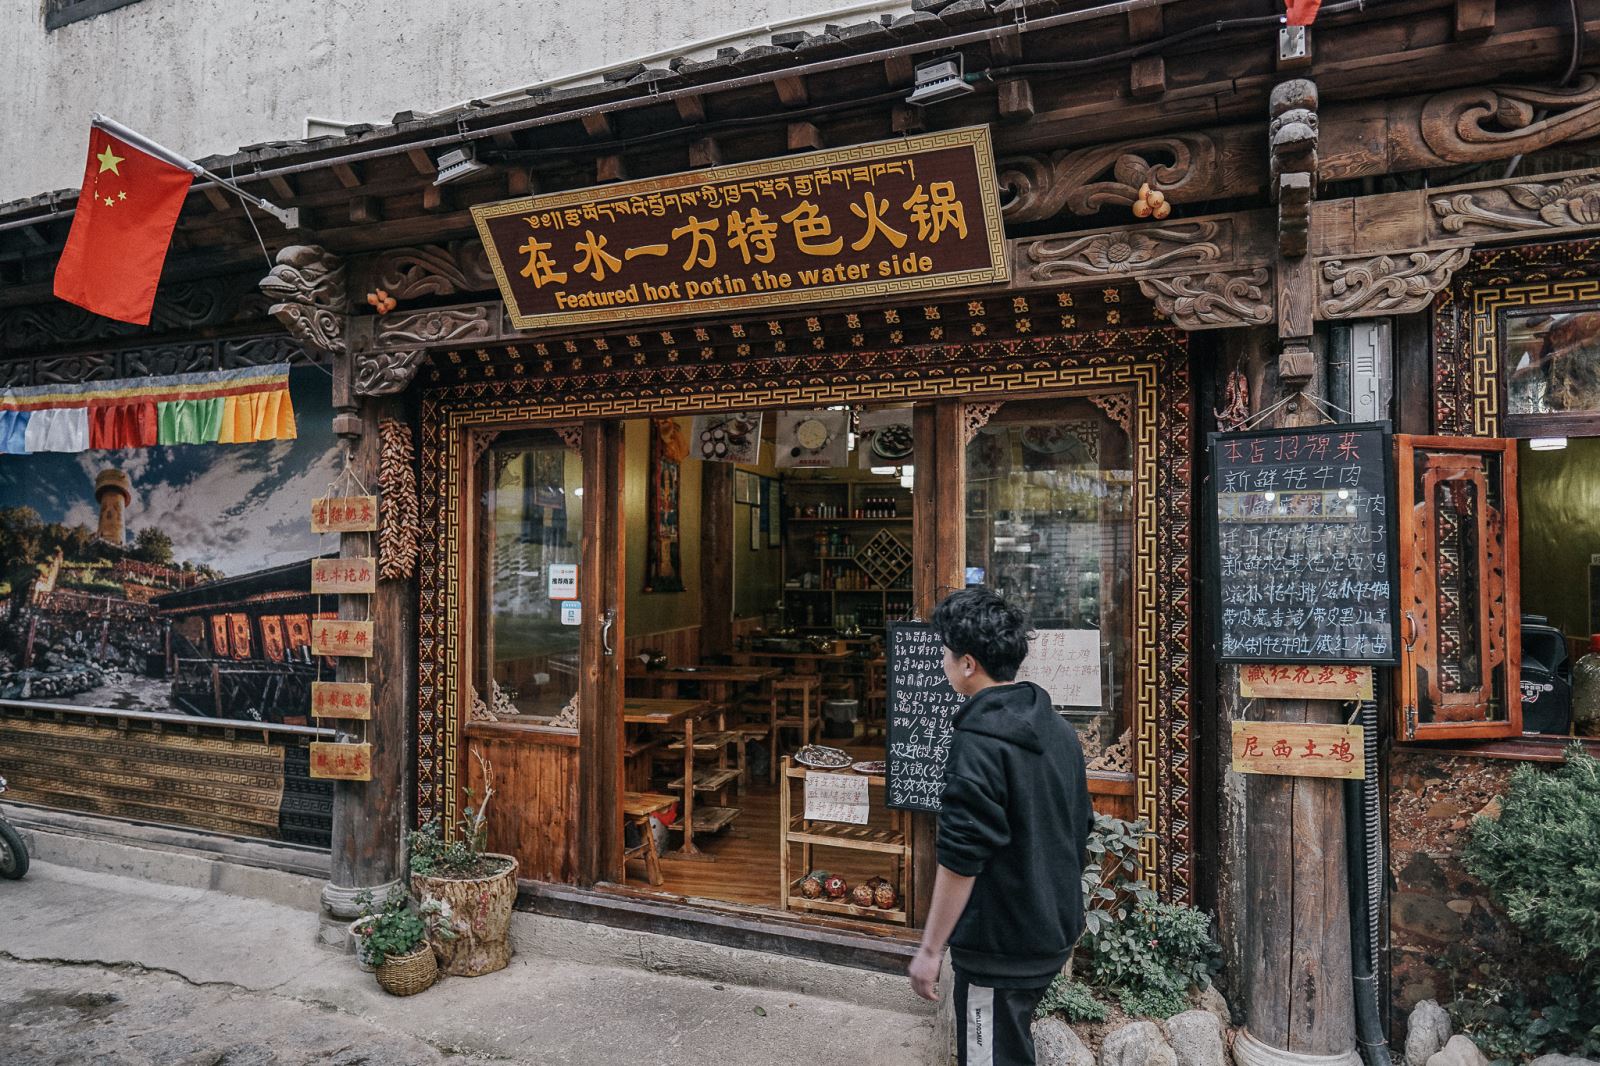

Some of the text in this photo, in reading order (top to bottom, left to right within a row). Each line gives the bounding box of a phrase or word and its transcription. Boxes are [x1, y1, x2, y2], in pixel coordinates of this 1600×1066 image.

[518, 180, 969, 290] 在水一方特色火锅
[554, 283, 640, 310] Featured
[643, 279, 679, 301] hot
[751, 269, 792, 291] the
[797, 261, 875, 287] water
[877, 252, 934, 277] side
[1223, 432, 1362, 464] 本店招牌菜
[1222, 463, 1362, 493] 新鲜牦牛肉
[1241, 736, 1356, 763] 尼西土鸡
